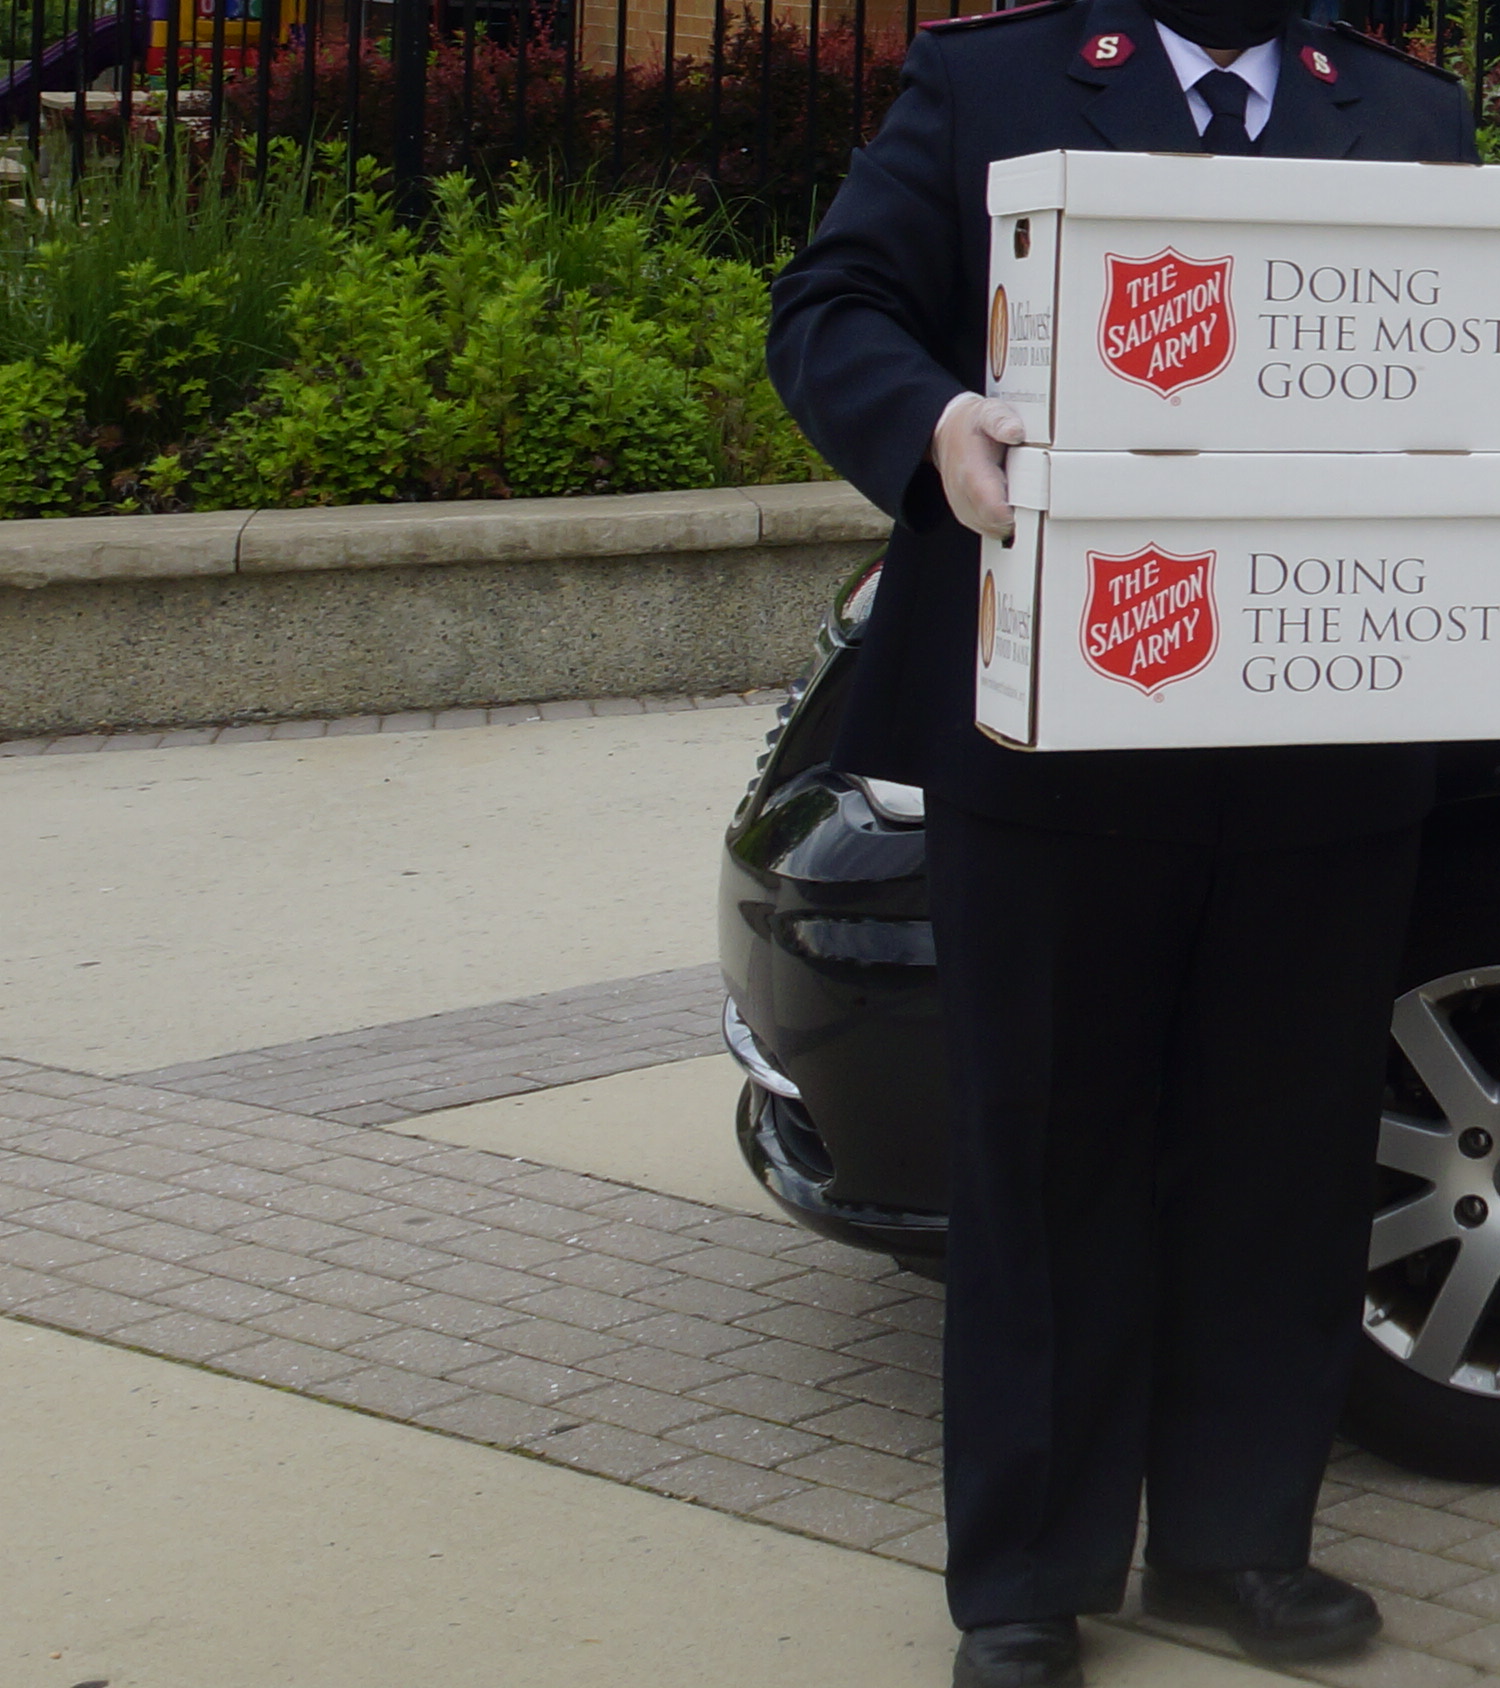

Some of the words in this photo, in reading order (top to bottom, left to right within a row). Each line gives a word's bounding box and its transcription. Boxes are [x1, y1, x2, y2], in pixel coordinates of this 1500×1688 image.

[1096, 36, 1119, 60] S
[1126, 263, 1177, 308] THE
[1264, 260, 1441, 305] DOING
[1107, 271, 1222, 359] SALVATION
[1259, 314, 1356, 353] THE
[1146, 323, 1216, 379] ARMY
[1258, 363, 1418, 401] GOOD
[1108, 558, 1159, 604] THE
[1248, 553, 1426, 595] DOING
[1089, 566, 1204, 657] SALVATION
[1242, 608, 1341, 644] THE
[1359, 605, 1500, 643] MOST
[1129, 618, 1199, 676] ARMY
[1242, 654, 1403, 693] GOOD
